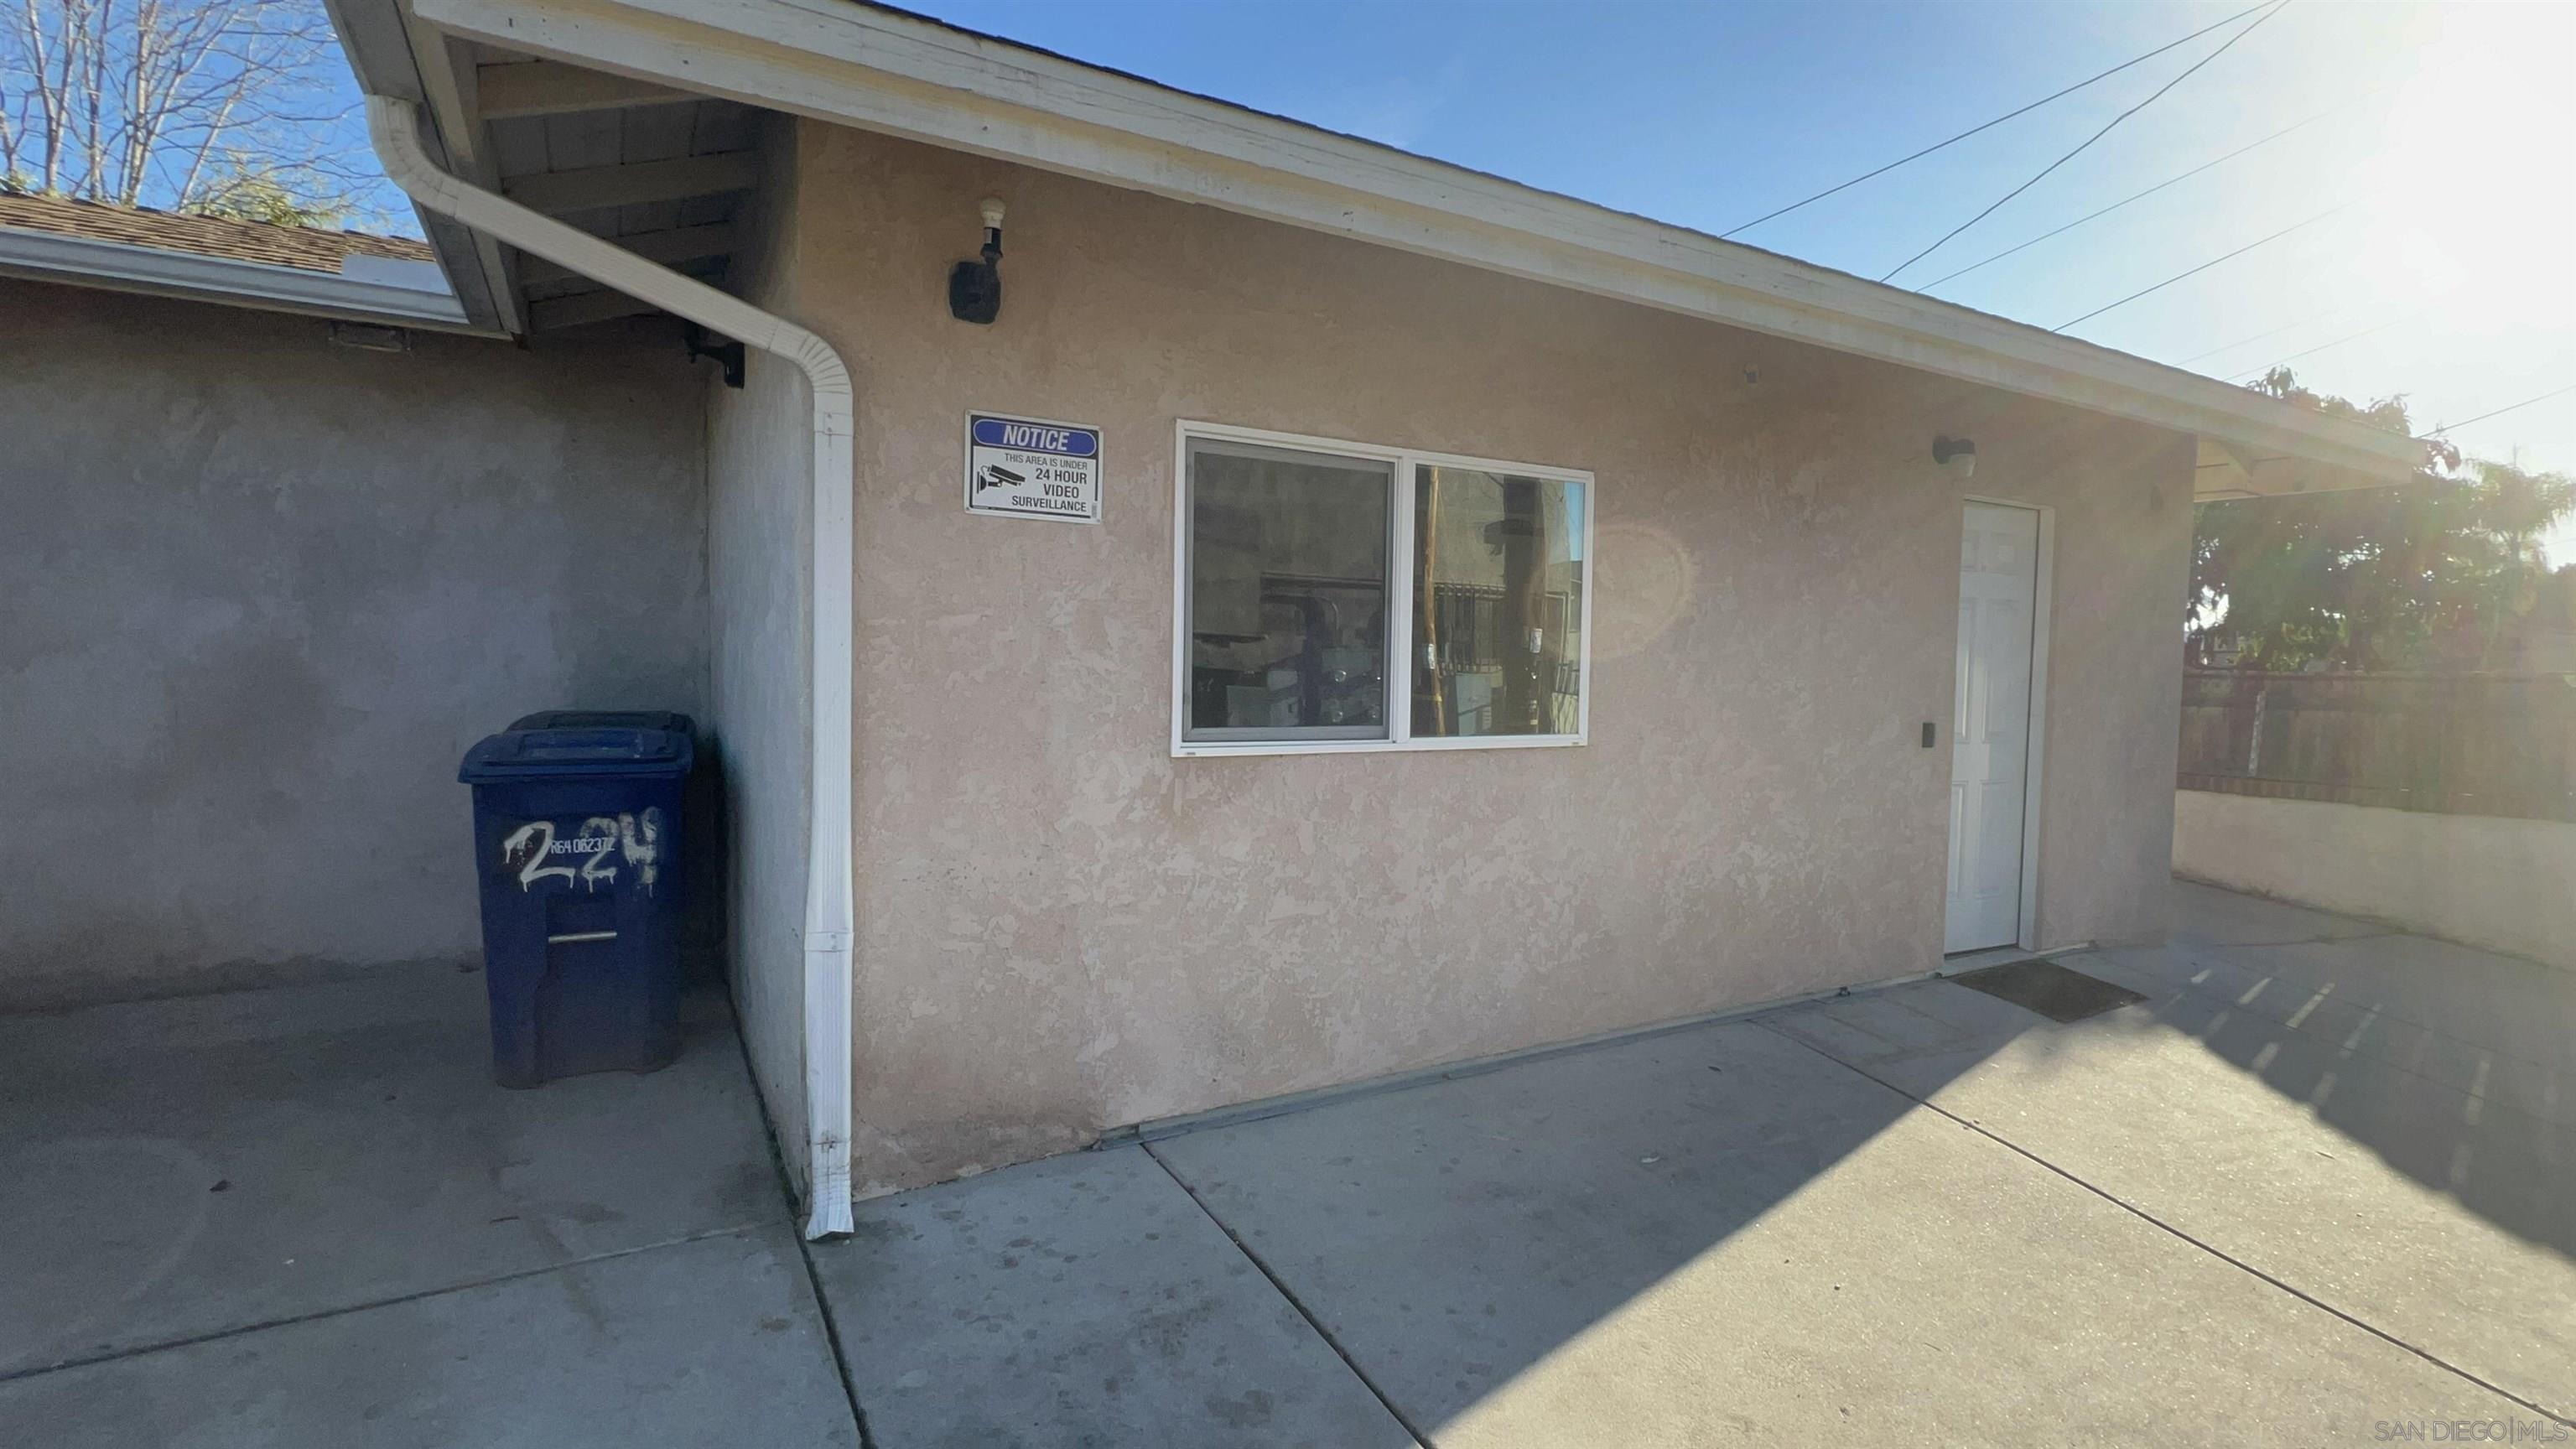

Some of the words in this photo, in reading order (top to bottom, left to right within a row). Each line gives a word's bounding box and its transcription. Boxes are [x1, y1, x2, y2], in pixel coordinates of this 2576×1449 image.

[1003, 425, 1070, 451] NOTICE
[1005, 453, 1024, 464] THIS
[1026, 455, 1047, 466] AREA
[1050, 458, 1058, 467] IS
[1060, 460, 1088, 470] UNDER
[1036, 468, 1051, 480] 24
[1054, 470, 1088, 485] HOUR
[1043, 483, 1079, 499] VIDEO
[1011, 495, 1087, 512] SURVEILLANCE
[505, 807, 661, 898] 224
